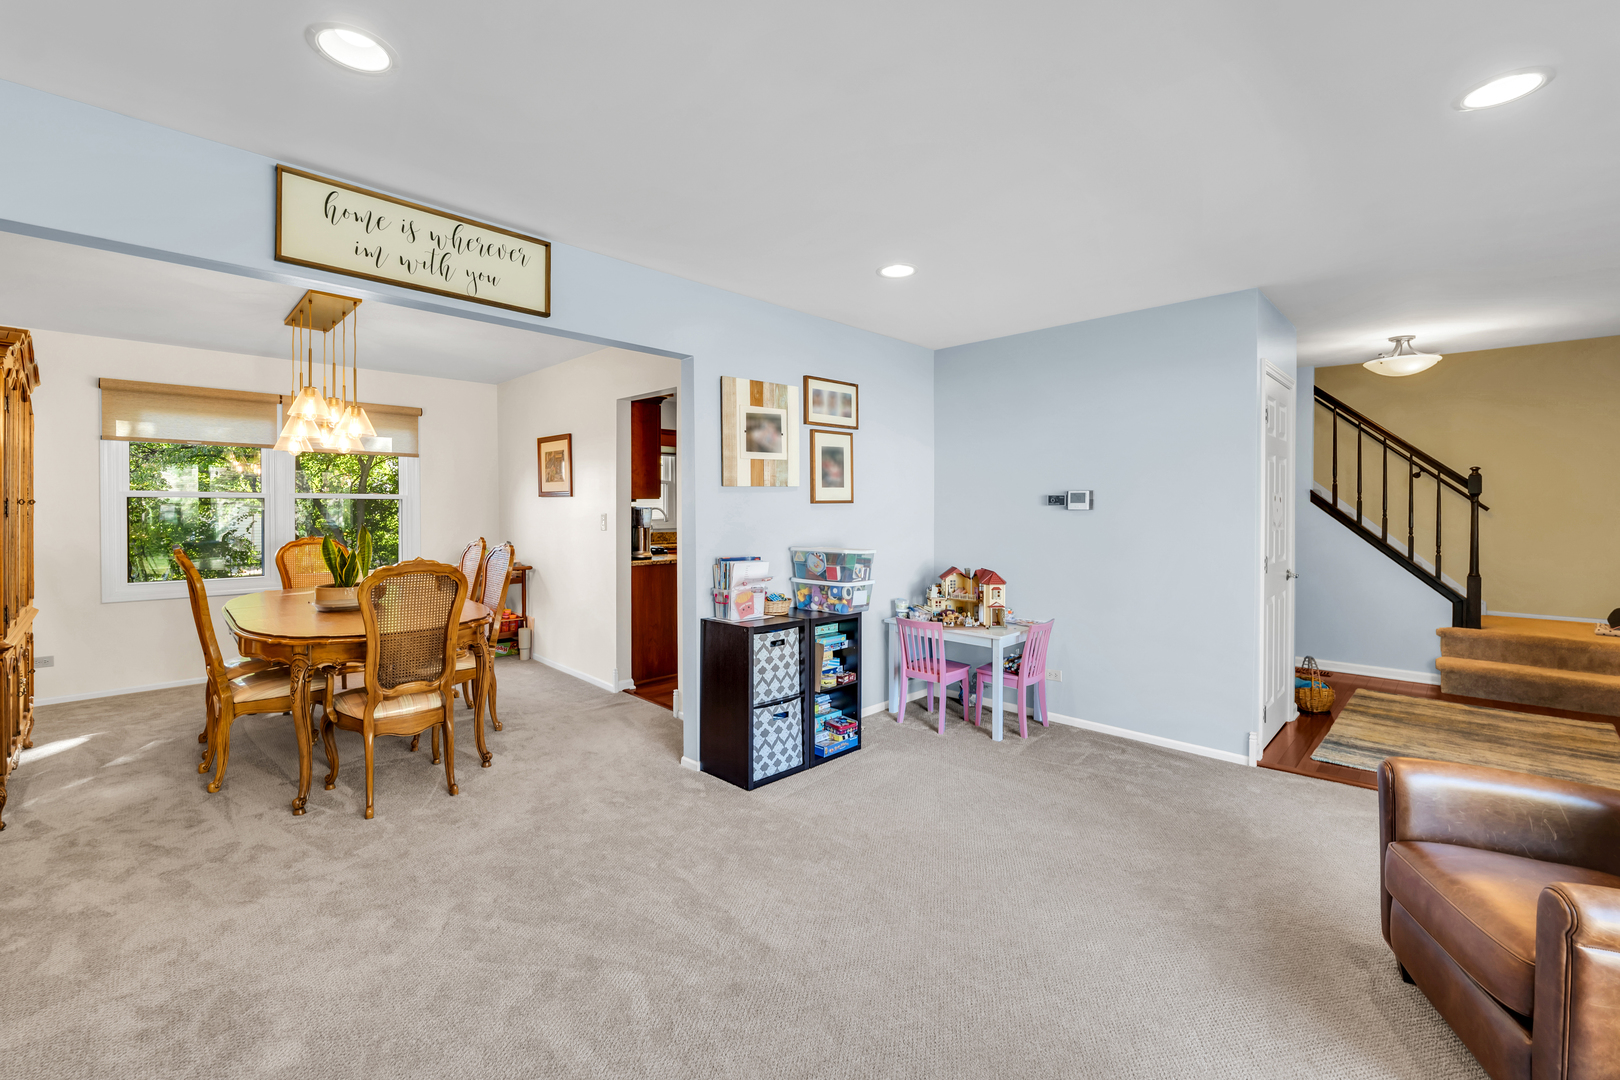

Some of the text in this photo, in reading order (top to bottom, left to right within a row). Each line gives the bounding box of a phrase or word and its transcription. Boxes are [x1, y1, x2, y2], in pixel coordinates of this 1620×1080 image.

[324, 191, 531, 267] home is wherever
[354, 241, 502, 297] im with you
